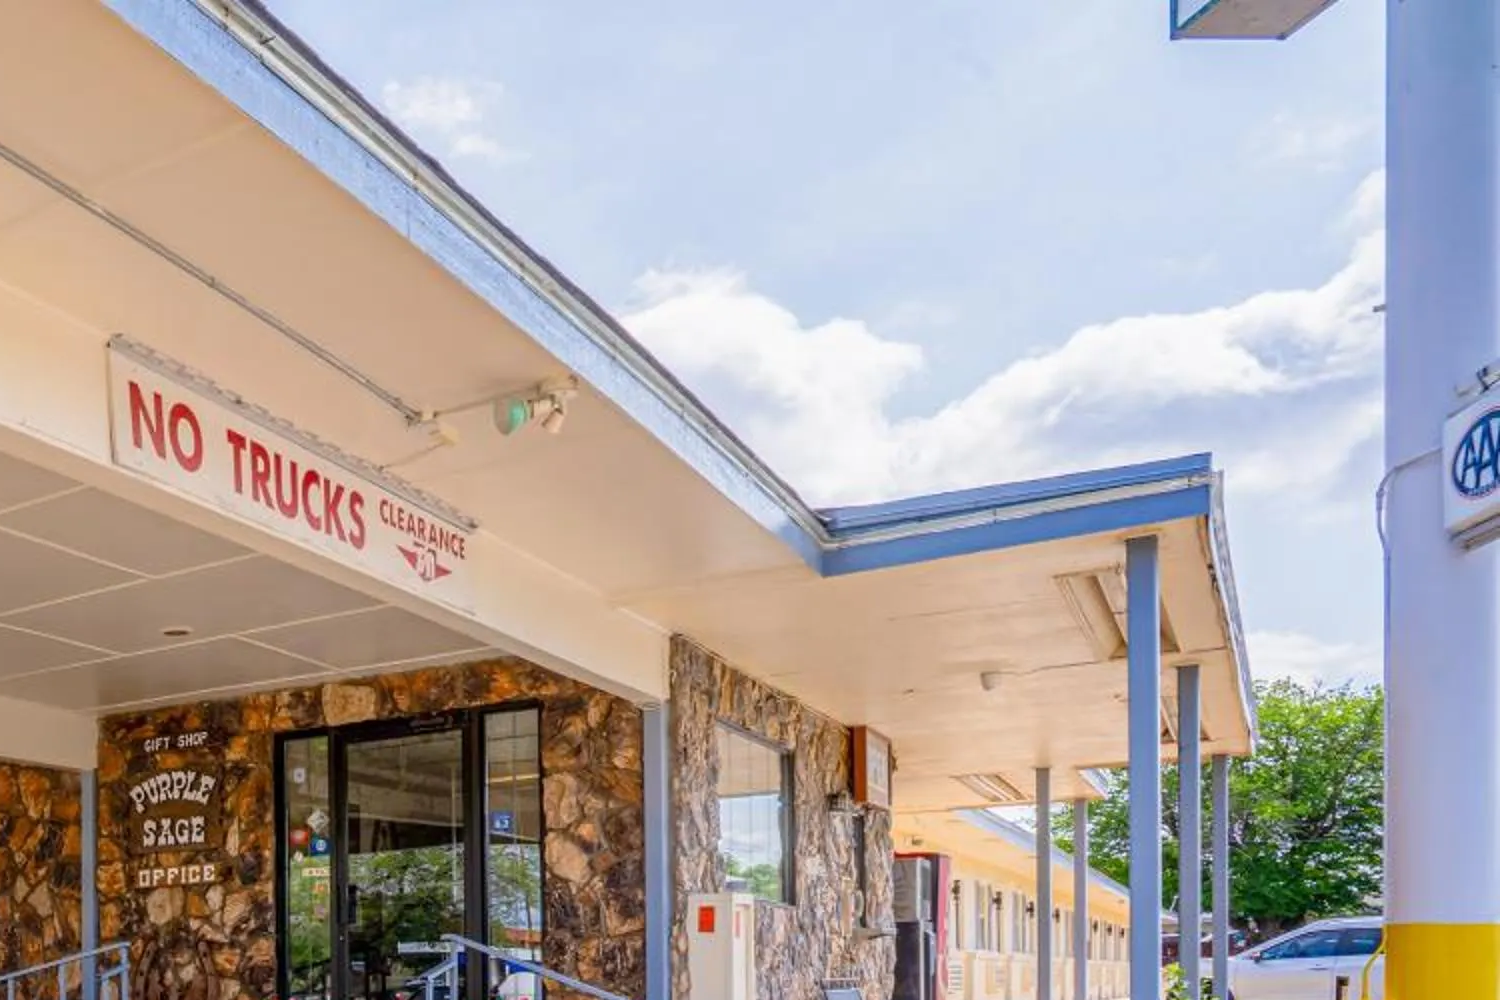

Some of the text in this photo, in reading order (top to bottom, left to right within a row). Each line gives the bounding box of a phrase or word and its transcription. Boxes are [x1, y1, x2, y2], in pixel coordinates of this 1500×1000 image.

[127, 380, 367, 551] NO TRUCKS
[379, 498, 466, 560] CLEARANCE
[144, 731, 209, 753] GIFT SHOP
[129, 770, 217, 814] PURPLE
[143, 815, 206, 848] SAGE
[138, 863, 216, 889] OFFICE
